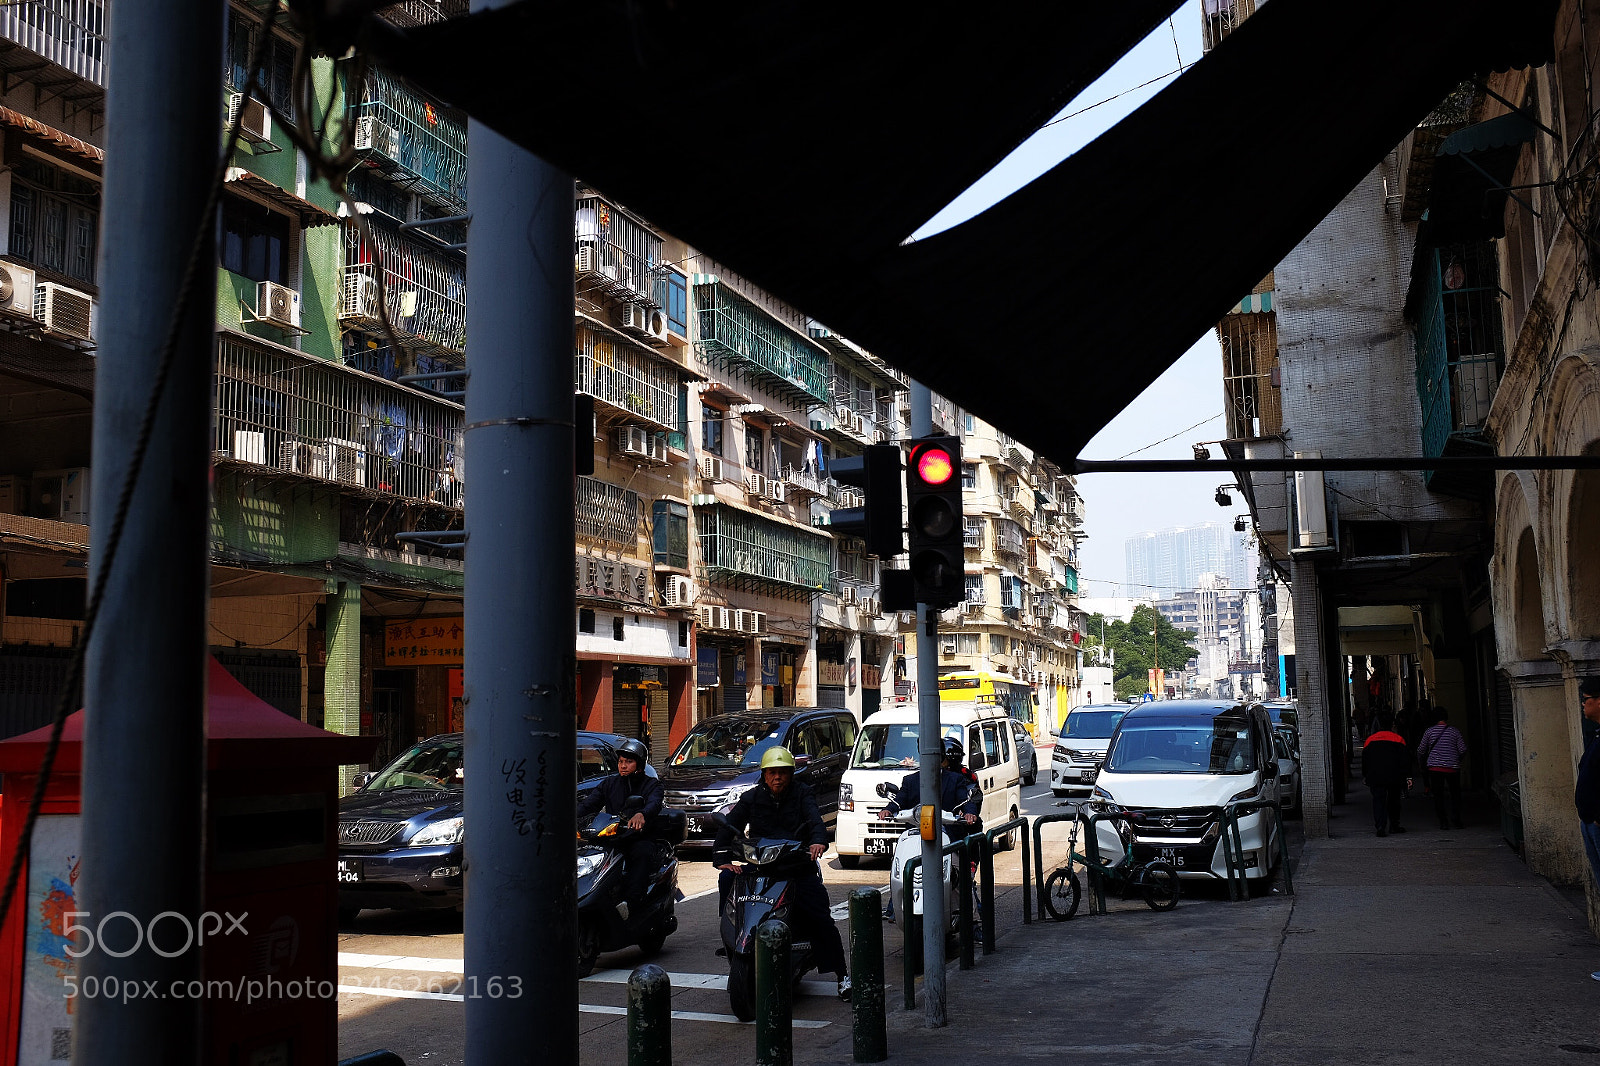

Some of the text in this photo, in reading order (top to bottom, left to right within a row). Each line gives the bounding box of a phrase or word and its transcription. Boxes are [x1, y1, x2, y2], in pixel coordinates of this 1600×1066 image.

[388, 623, 464, 640] 漁民互助會
[866, 845, 890, 854] 93-01
[1162, 848, 1175, 857] MX
